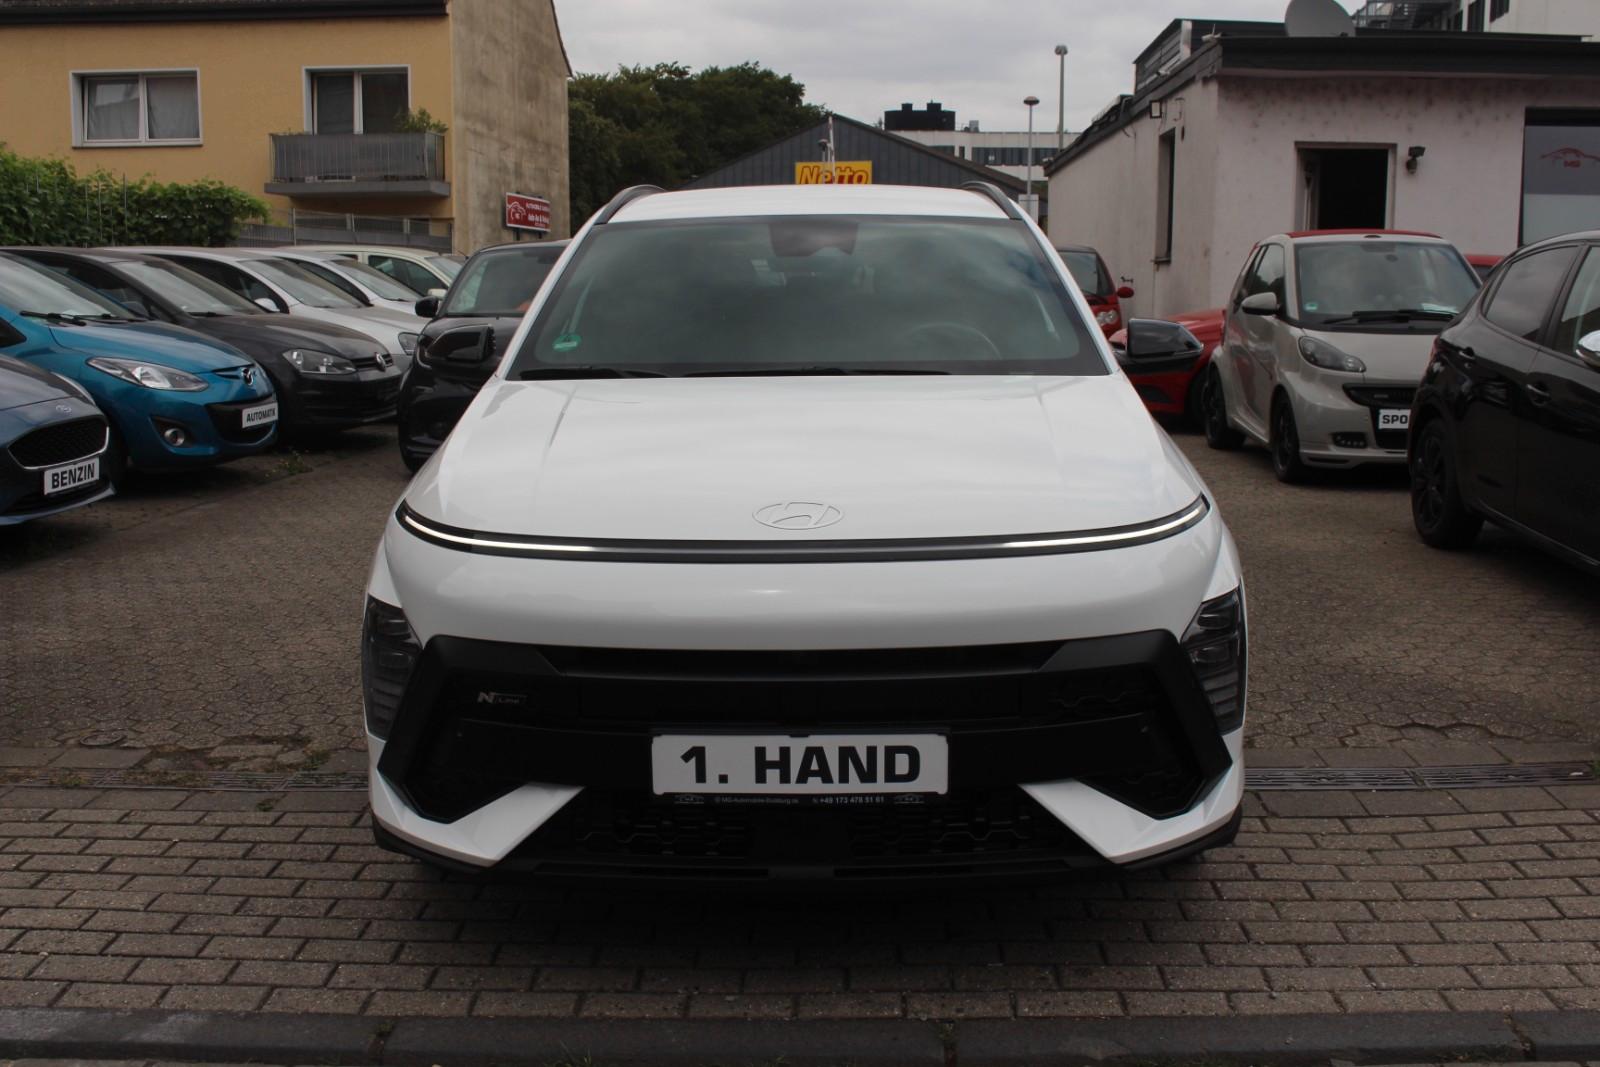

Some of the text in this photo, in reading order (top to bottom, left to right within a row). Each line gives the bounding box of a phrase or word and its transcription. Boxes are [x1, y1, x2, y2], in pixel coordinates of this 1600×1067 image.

[800, 166, 869, 184] Netto
[1382, 414, 1408, 424] SPO
[51, 462, 95, 489] BENZIN
[680, 745, 920, 784] 1. HAND
